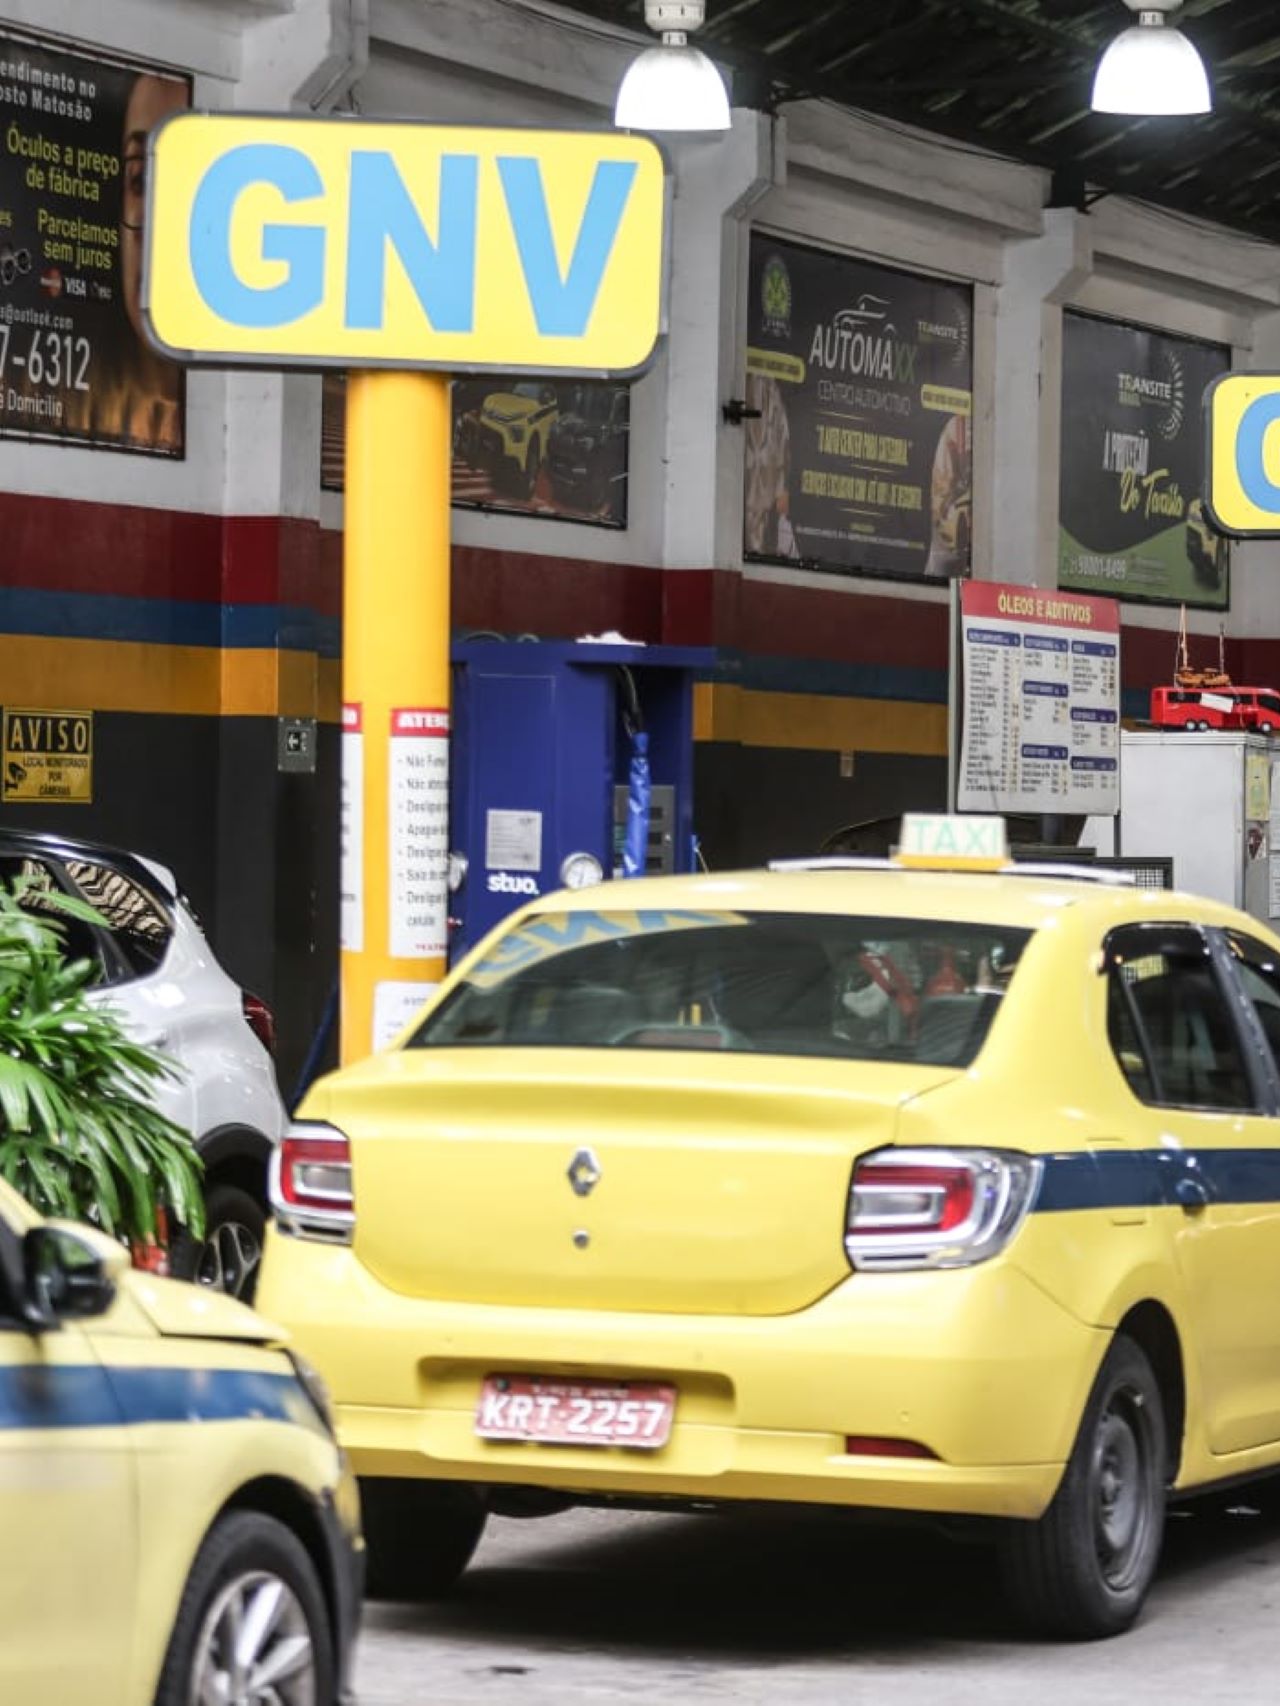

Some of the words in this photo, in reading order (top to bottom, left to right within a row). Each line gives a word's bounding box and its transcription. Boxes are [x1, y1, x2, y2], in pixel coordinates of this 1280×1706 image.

[79, 80, 96, 99] no
[7, 121, 60, 163] Óculos
[64, 146, 74, 167] a
[78, 148, 120, 180] preço
[26, 161, 45, 190] de
[49, 166, 100, 202] fábrica
[37, 208, 119, 248] Parcelamos
[188, 142, 640, 339] GNV
[43, 240, 74, 263] sem
[75, 241, 113, 271] juros
[1036, 600, 1044, 618] E
[1046, 601, 1092, 625] ADITIVOS
[10, 717, 88, 753] AVISO
[912, 820, 999, 856] TAXI
